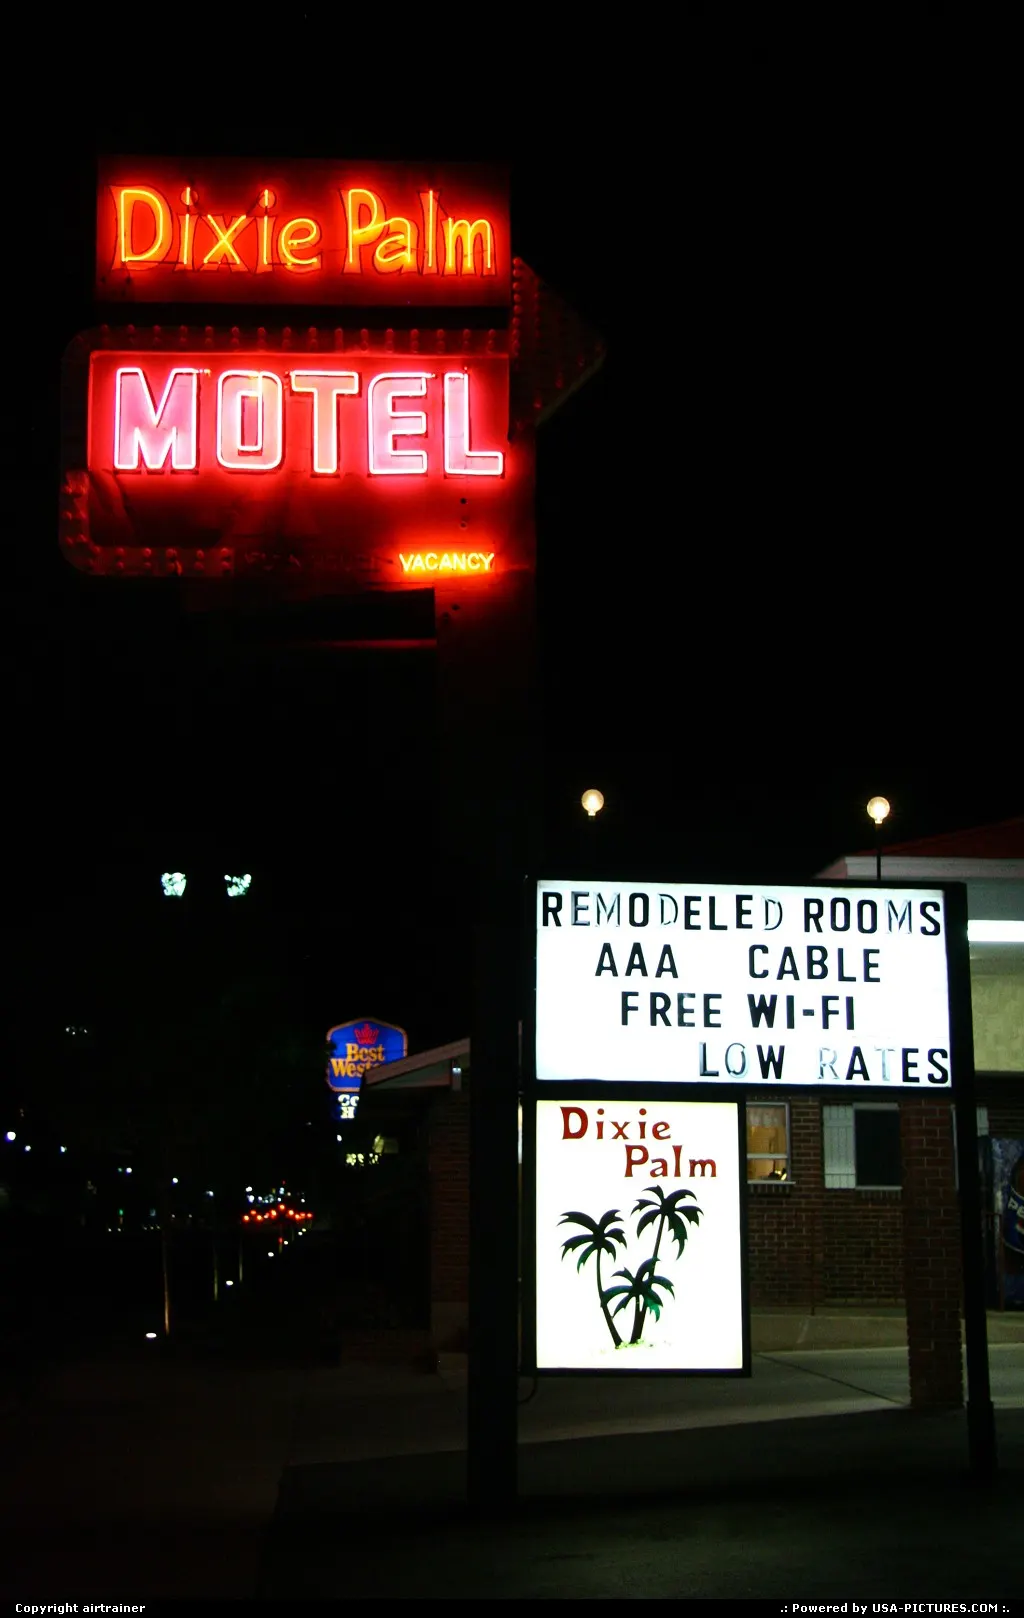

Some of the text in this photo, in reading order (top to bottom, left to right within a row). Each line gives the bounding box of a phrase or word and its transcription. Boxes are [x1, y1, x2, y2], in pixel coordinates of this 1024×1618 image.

[109, 184, 497, 276] Dixie Palm
[113, 366, 504, 477] MOTEL
[399, 552, 495, 573] VACANCY
[541, 889, 942, 937] REMODELED ROOMS
[594, 942, 881, 983] AAA CABLE
[620, 991, 856, 1031] FREE WI-FI
[346, 1042, 385, 1062] Best
[698, 1041, 950, 1085] LOW RATES
[559, 1106, 671, 1140] Dixie
[624, 1144, 717, 1178] Palm
